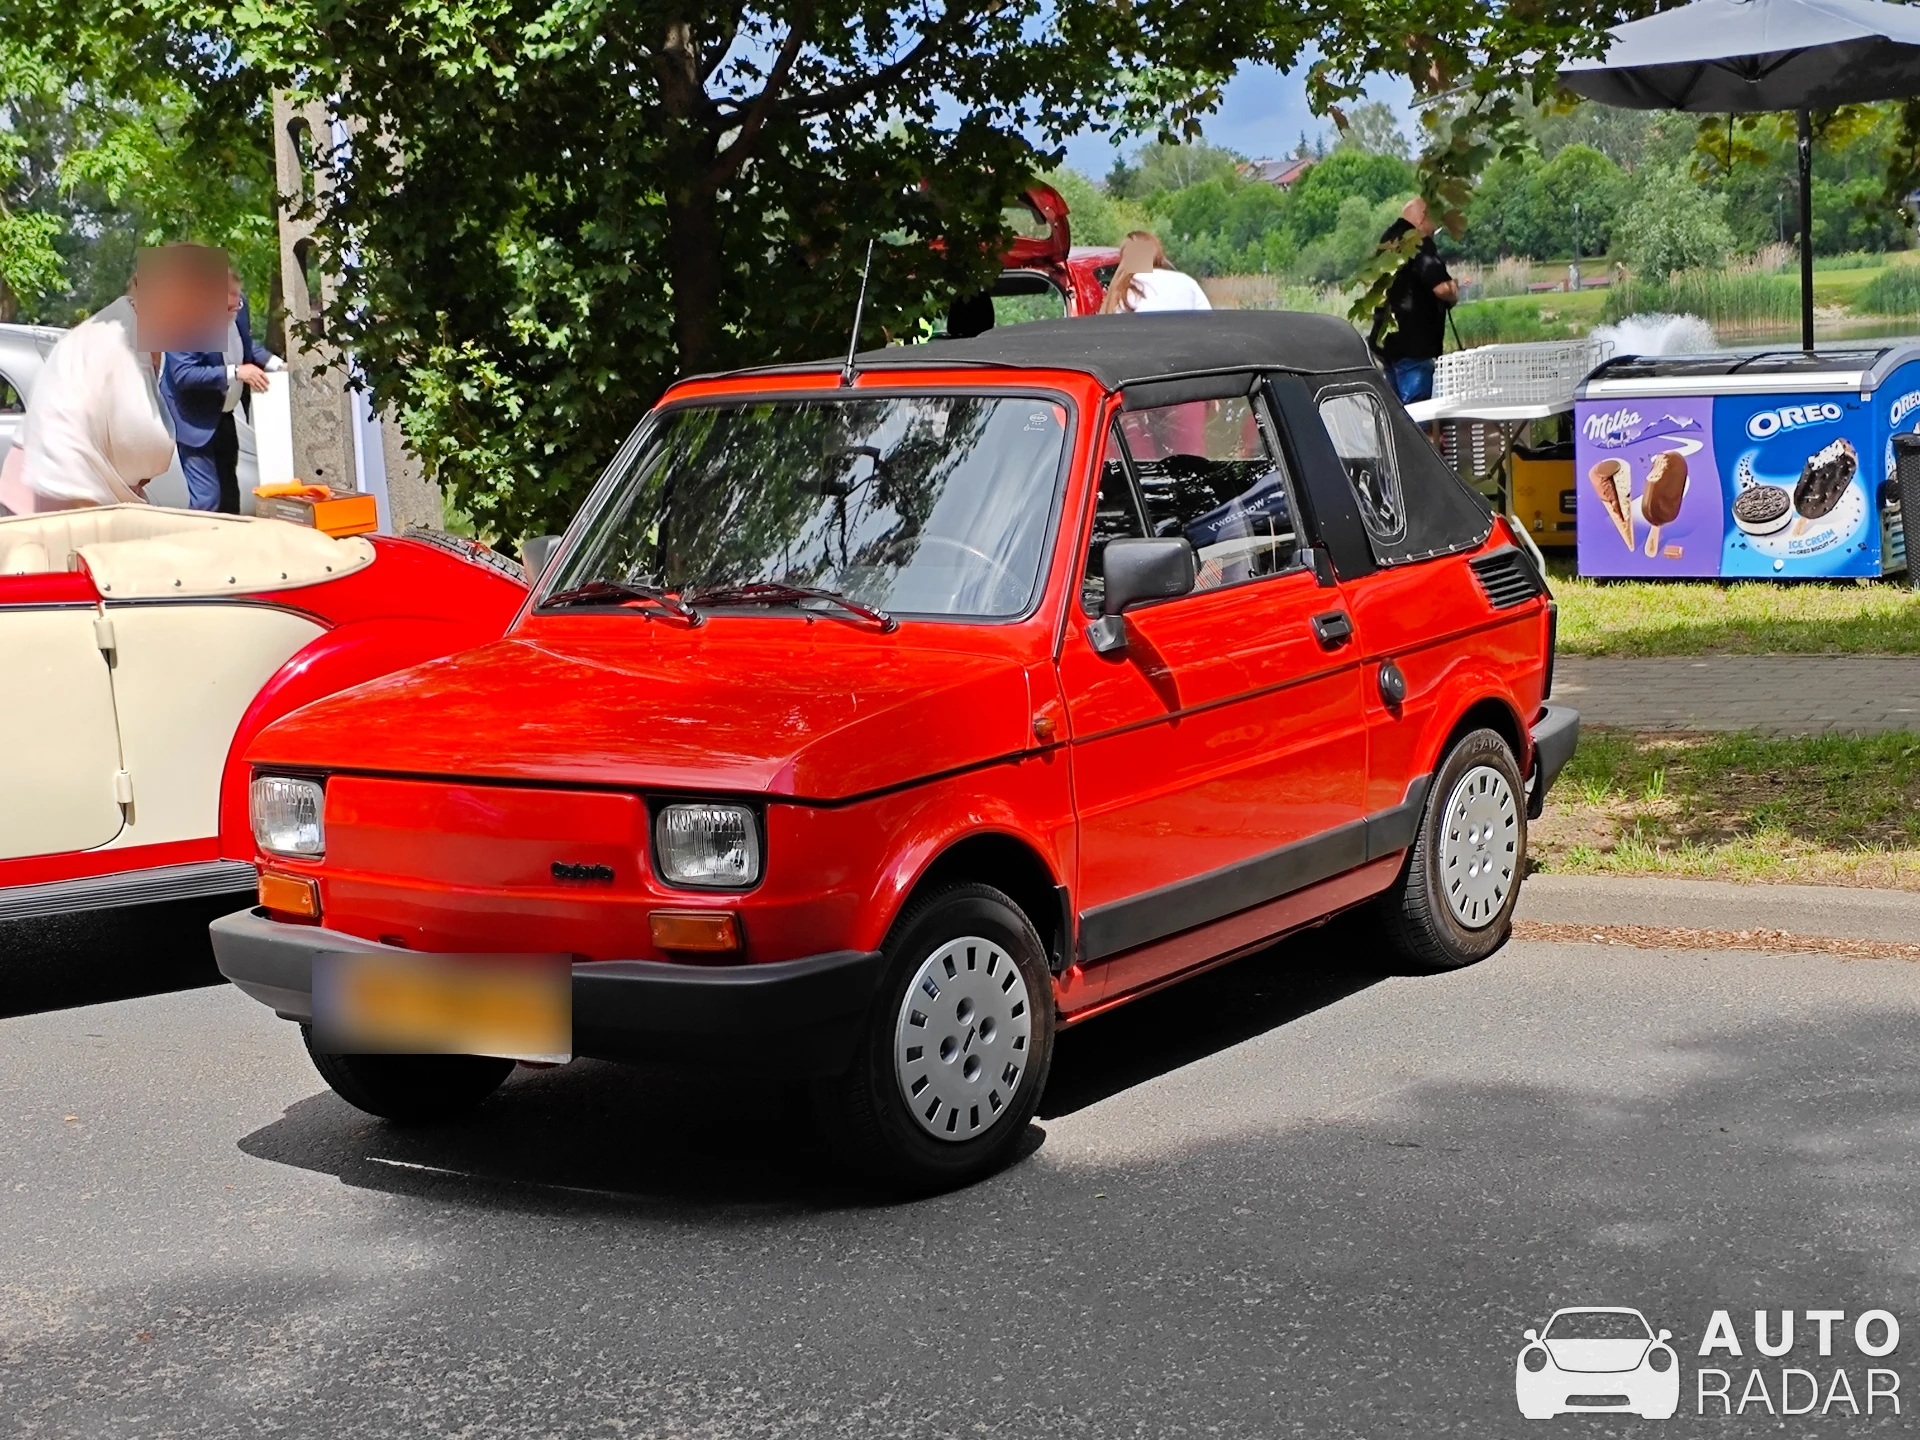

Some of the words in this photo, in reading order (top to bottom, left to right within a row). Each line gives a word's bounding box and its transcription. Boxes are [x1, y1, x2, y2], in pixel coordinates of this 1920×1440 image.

[1749, 403, 1840, 437] OREO
[1890, 391, 1920, 424] OREO
[1582, 408, 1642, 440] Milka
[1788, 540, 1804, 549] ICE
[1805, 528, 1835, 547] CREAM
[1472, 738, 1504, 757] SAVA
